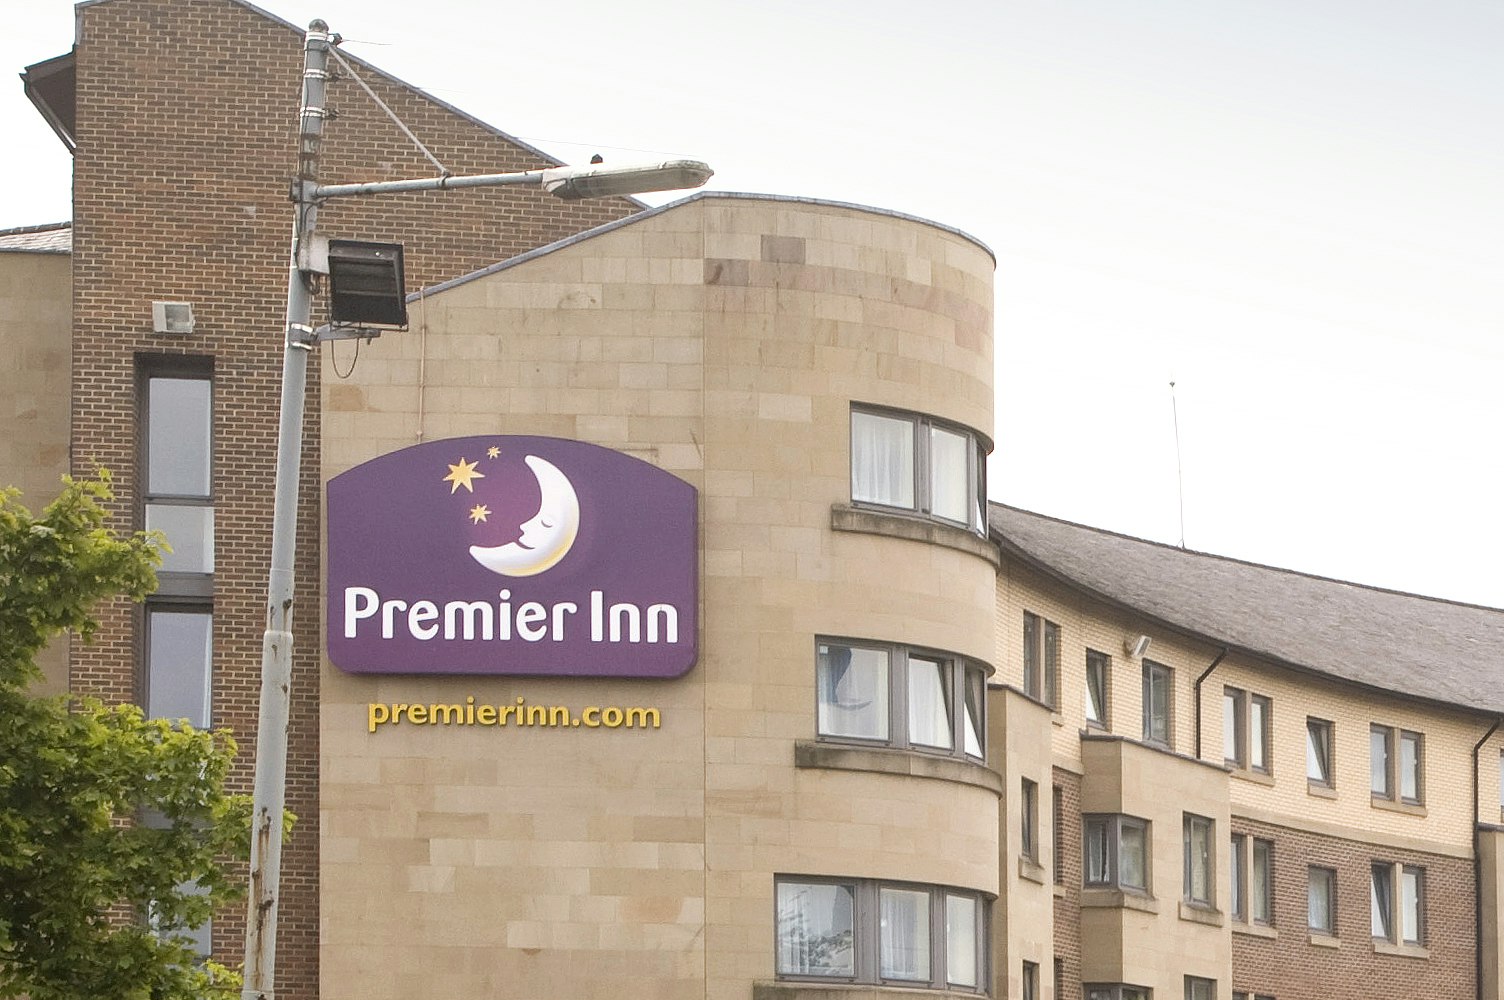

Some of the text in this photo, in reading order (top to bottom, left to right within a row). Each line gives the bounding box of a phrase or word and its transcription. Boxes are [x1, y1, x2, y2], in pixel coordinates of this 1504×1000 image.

[344, 586, 678, 643] Premier Inn
[368, 696, 661, 732] premierinn.com
